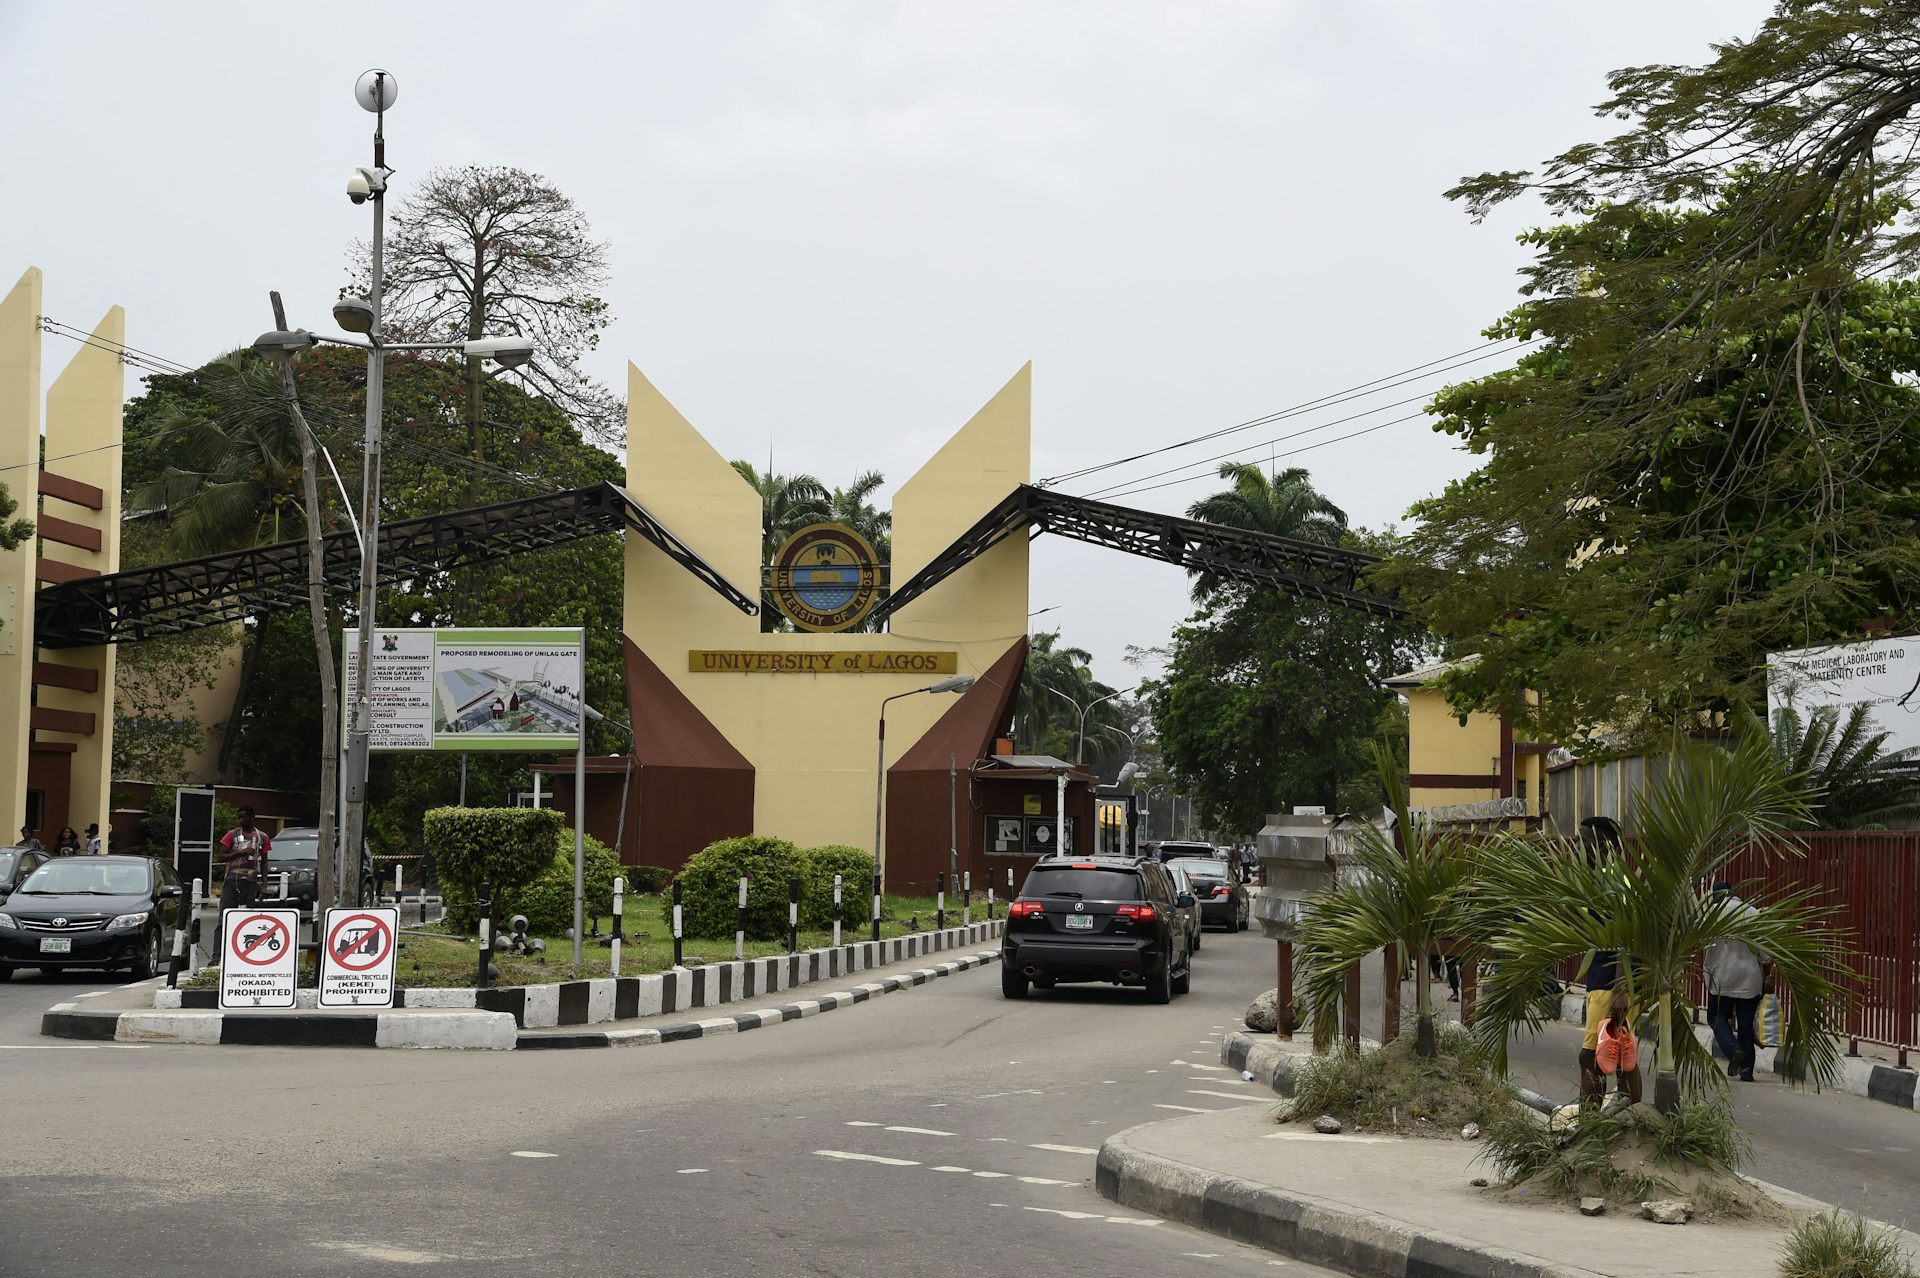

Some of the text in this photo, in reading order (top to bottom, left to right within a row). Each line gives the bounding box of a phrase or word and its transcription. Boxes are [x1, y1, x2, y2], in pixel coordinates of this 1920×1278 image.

[779, 570, 873, 625] UNIVERSITY OF LAGOS
[702, 653, 937, 670] UNIVERSITY of LAGOS
[1812, 657, 1842, 669] MEDICAL
[1843, 650, 1888, 666] LABORATORY
[1889, 648, 1905, 659] AND
[1810, 664, 1886, 682] MATERNITY CENTRE
